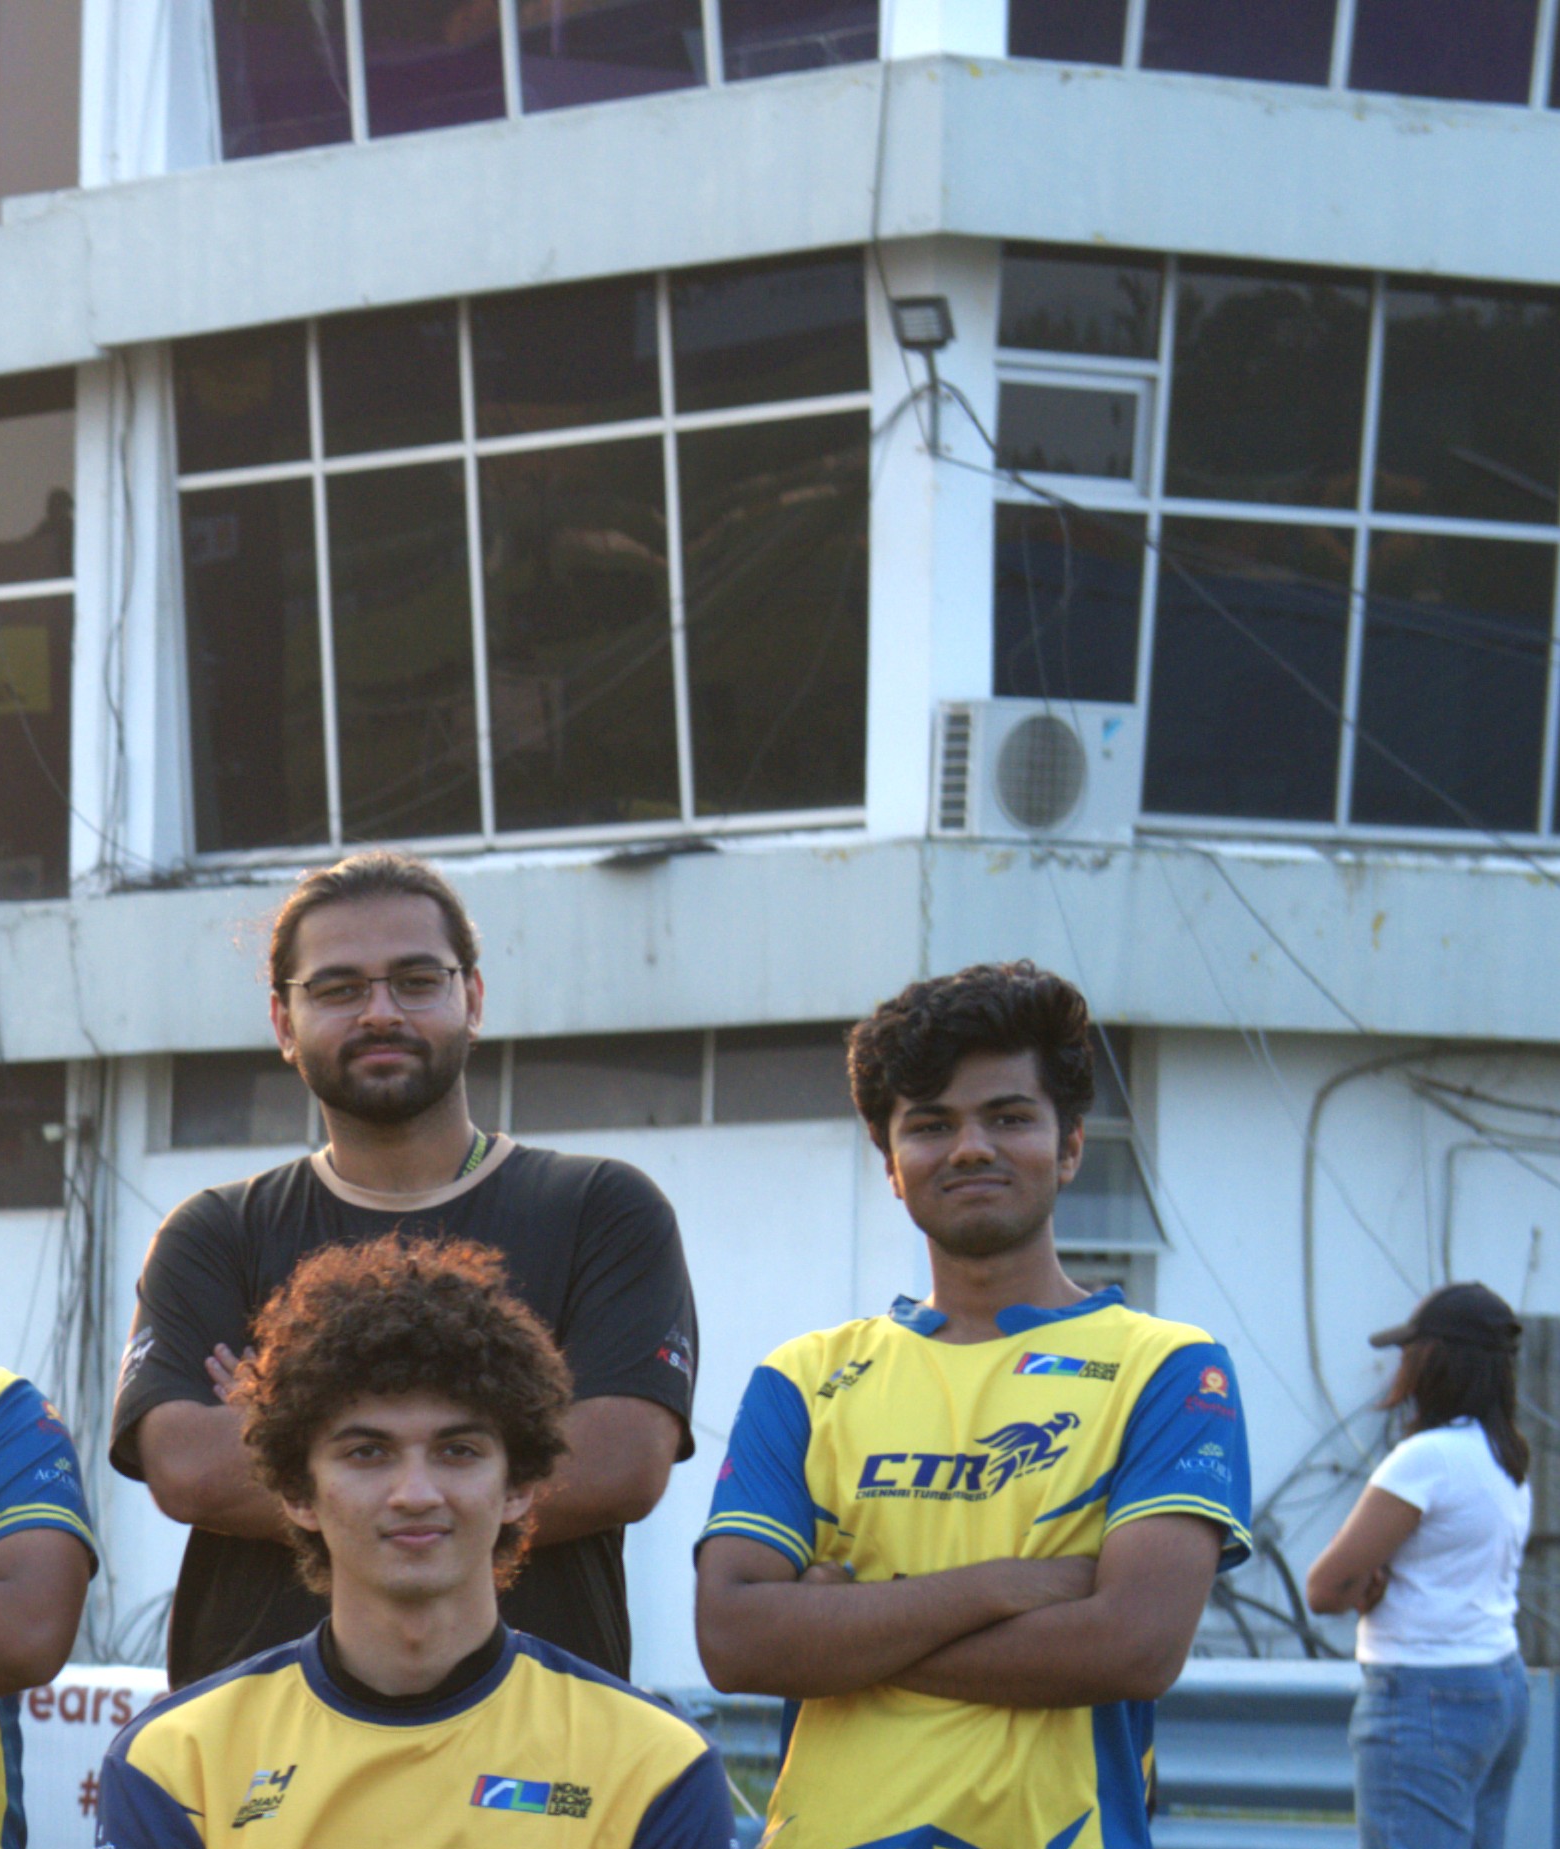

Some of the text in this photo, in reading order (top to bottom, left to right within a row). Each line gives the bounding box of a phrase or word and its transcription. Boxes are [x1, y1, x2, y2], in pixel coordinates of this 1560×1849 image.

[857, 1453, 990, 1491] CTR
[856, 1489, 910, 1500] CHENNAI
[245, 1765, 298, 1802] F4
[553, 1783, 590, 1795] INDIAN
[551, 1794, 592, 1806] RACING
[547, 1803, 587, 1818] LEAGUE
